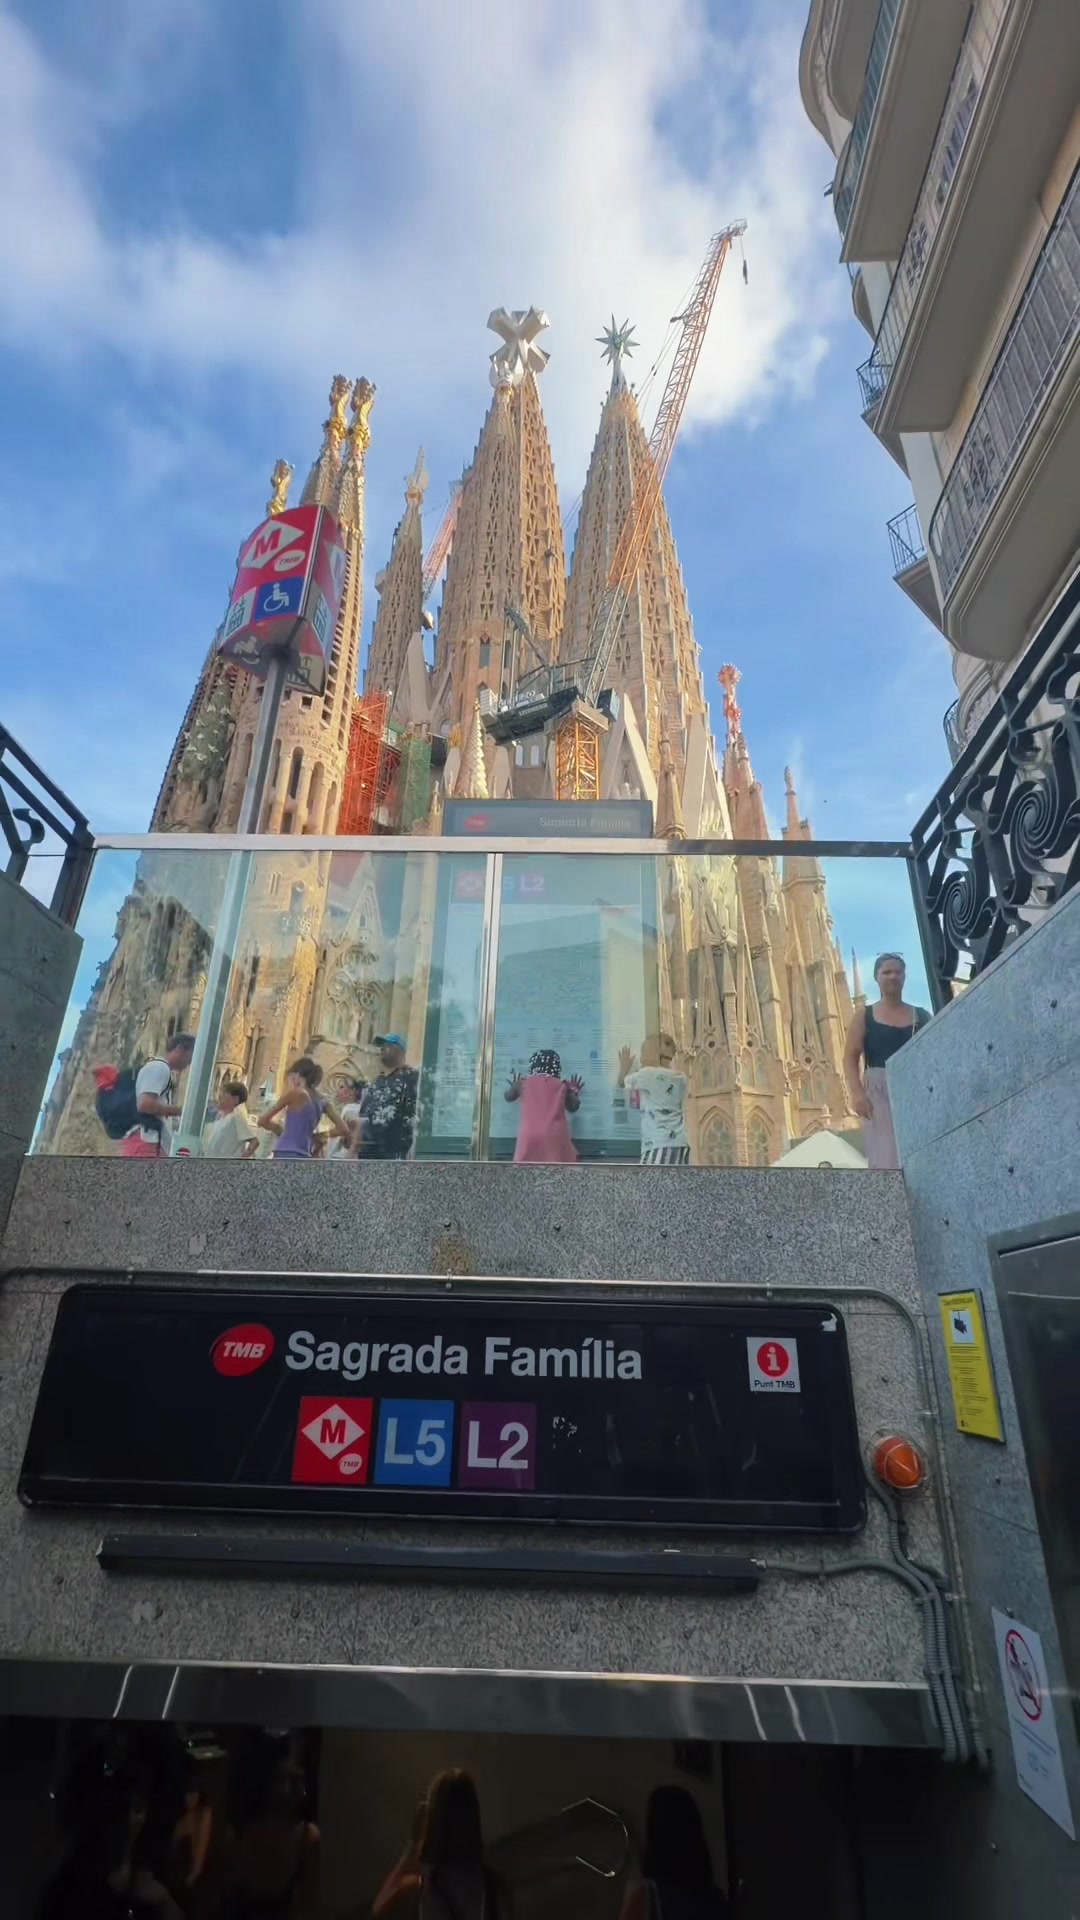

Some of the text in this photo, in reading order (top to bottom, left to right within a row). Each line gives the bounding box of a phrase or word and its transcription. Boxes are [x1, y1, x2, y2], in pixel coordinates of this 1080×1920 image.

[252, 527, 282, 561] M
[520, 875, 544, 891] L2
[222, 1341, 266, 1359] TMB
[285, 1330, 642, 1381] Sagrada Família
[754, 1380, 796, 1389] Punt TMB
[320, 1418, 346, 1444] M
[384, 1416, 529, 1470] L5 L2
[343, 1460, 360, 1468] TMB
